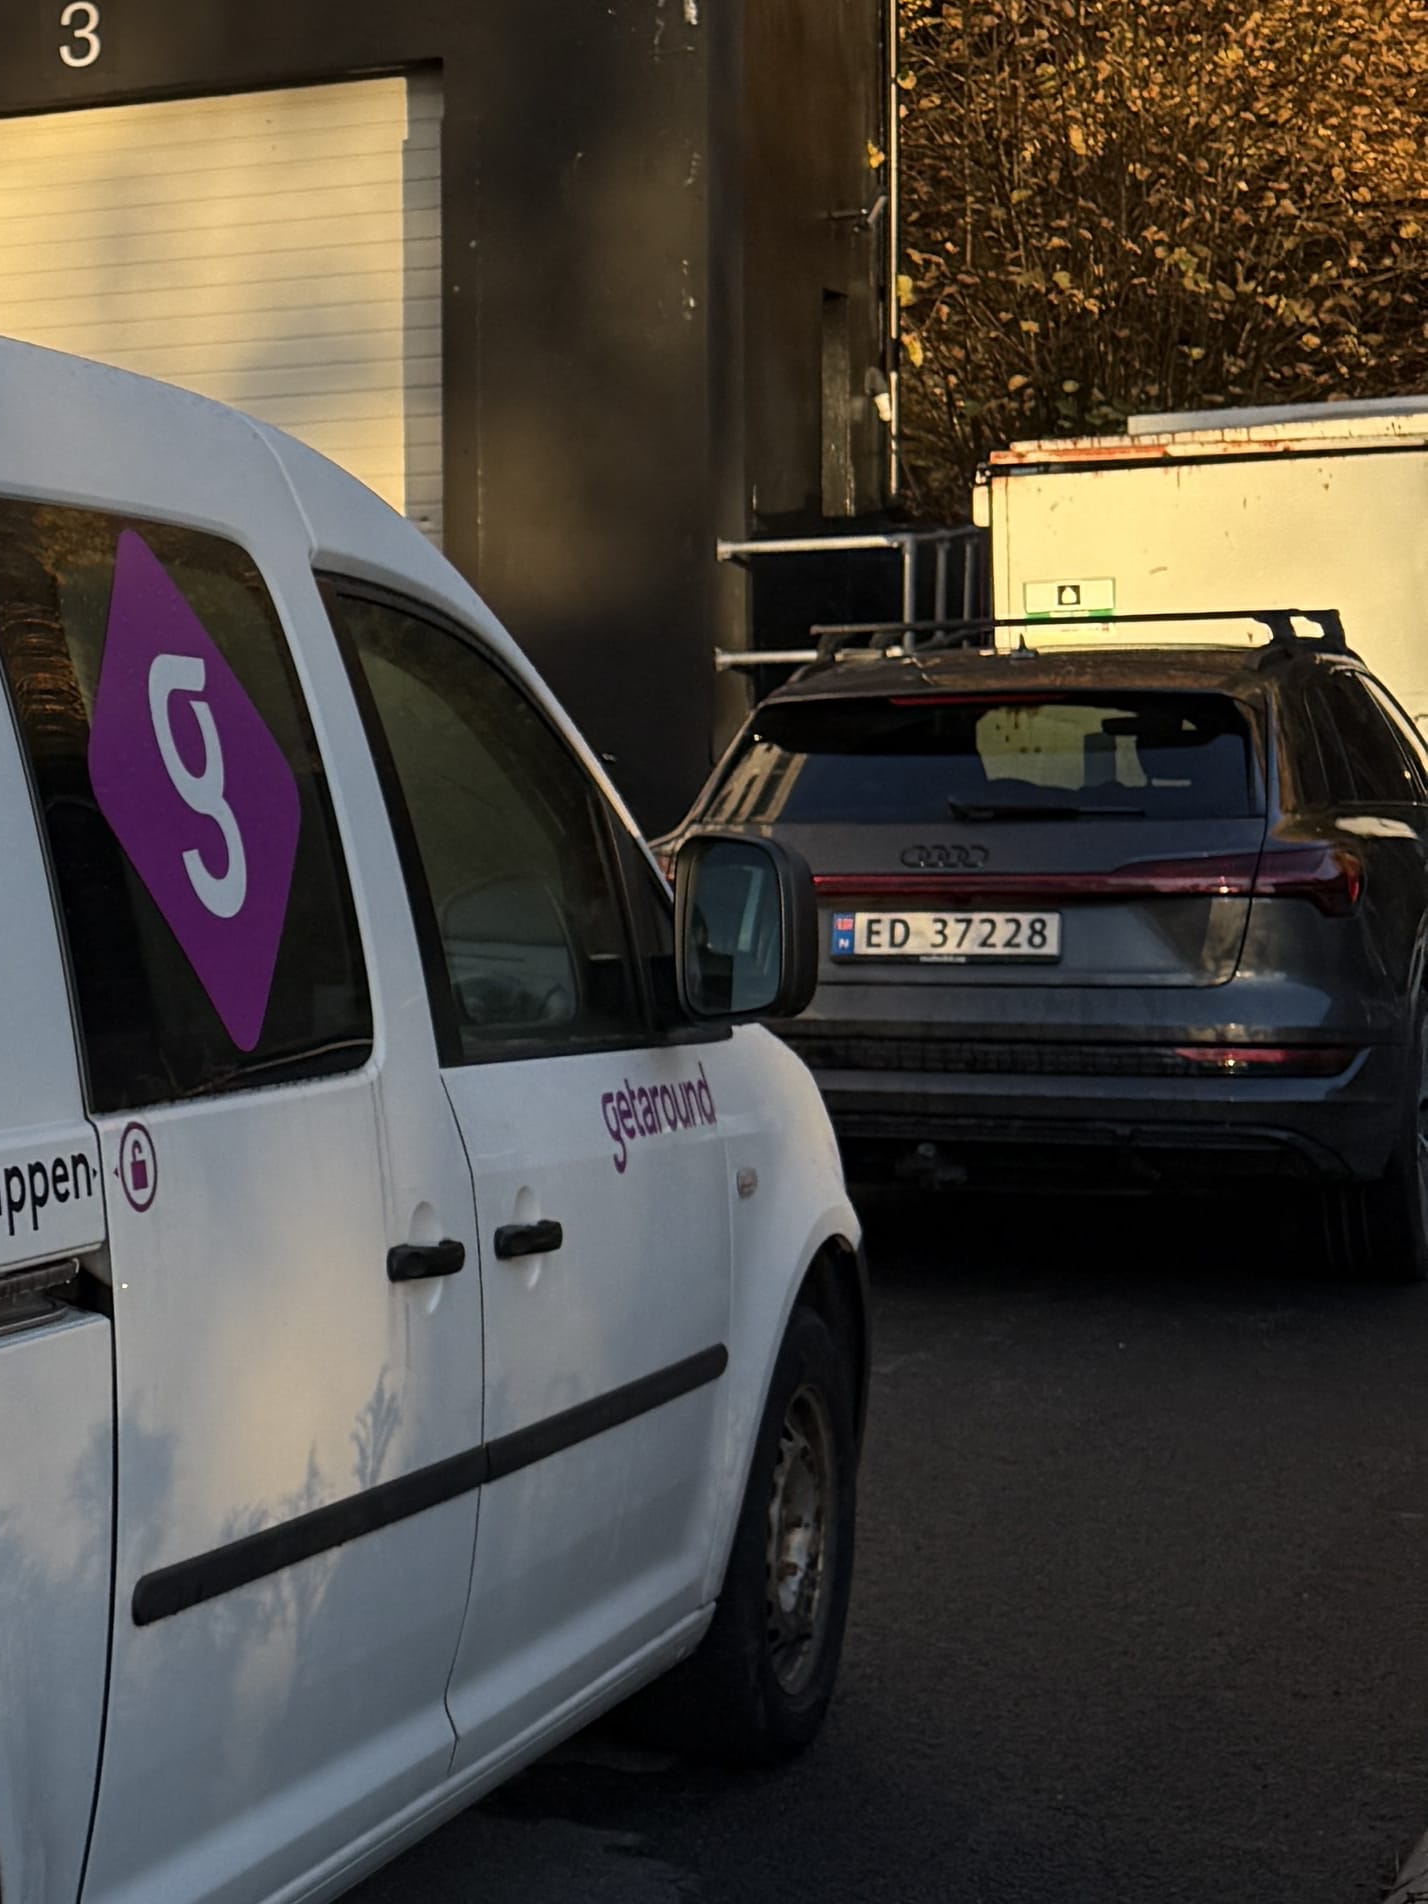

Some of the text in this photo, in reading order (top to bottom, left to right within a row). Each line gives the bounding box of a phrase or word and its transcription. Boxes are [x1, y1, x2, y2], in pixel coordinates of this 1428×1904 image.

[59, 0, 102, 68] 3
[148, 653, 248, 919] g
[865, 918, 1048, 949] ED 37228
[601, 1060, 718, 1174] getaround
